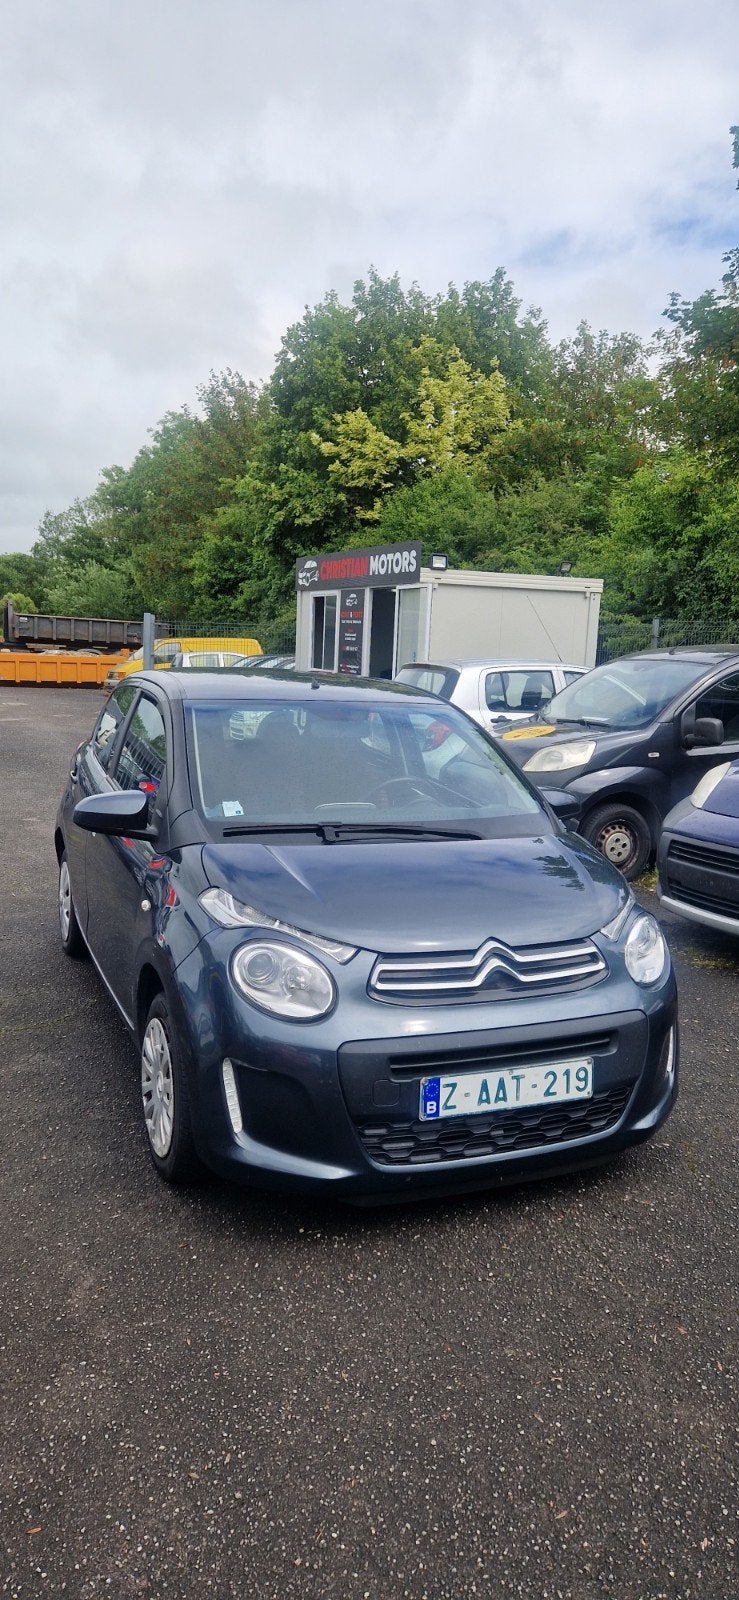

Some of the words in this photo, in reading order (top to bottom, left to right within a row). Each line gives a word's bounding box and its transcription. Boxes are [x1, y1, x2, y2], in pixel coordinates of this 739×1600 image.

[320, 556, 368, 580] CHRISTIAN
[369, 549, 417, 576] MOTORS
[426, 1101, 437, 1114] B
